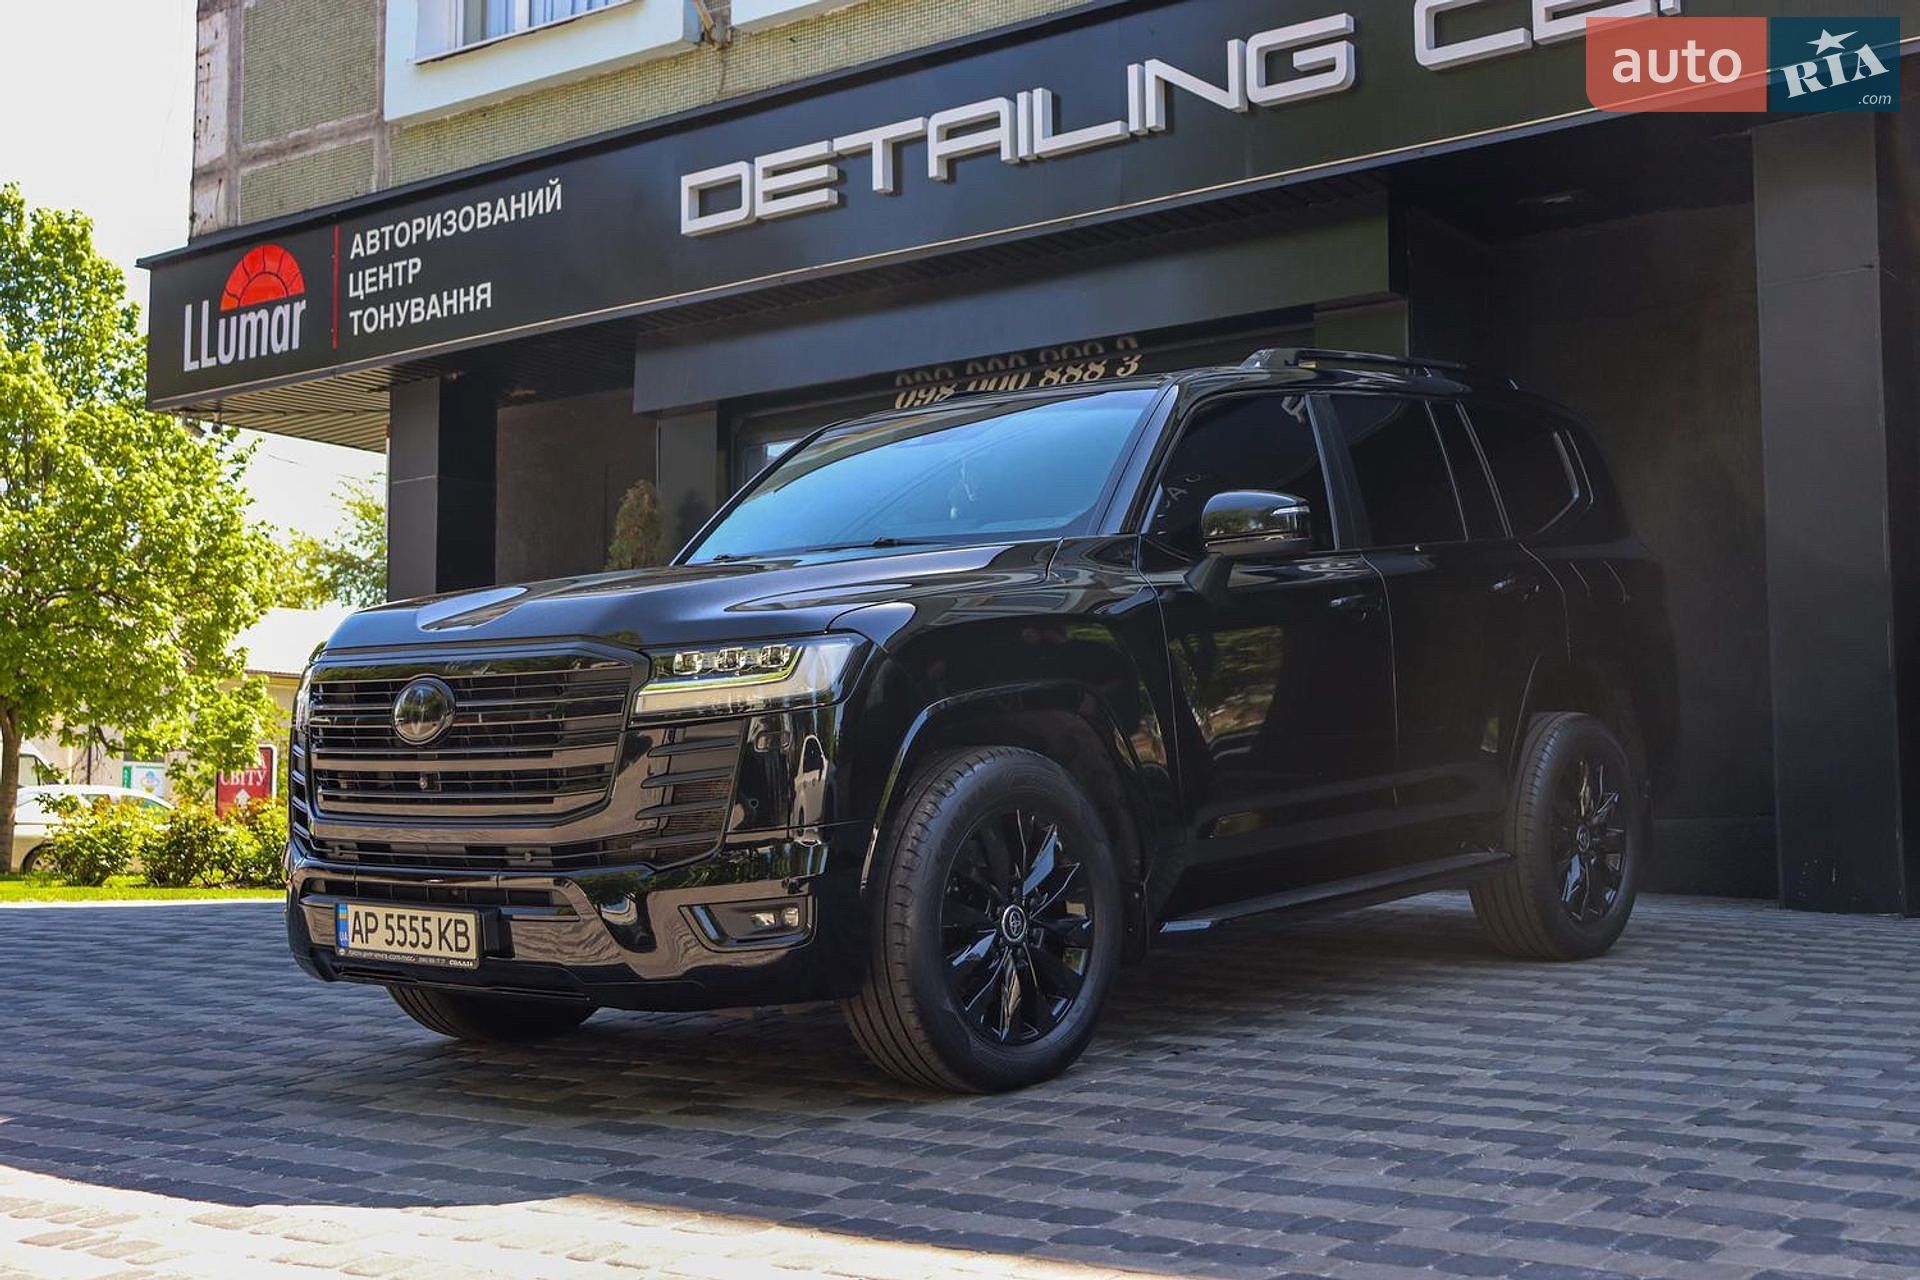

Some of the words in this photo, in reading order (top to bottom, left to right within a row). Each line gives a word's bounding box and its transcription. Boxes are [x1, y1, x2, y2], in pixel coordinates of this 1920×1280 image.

[681, 12, 1356, 236] DETAILING
[1414, 0, 1682, 71] CE
[349, 178, 563, 259] АВТОРИЗОВАНИЙ
[348, 257, 422, 300] ЦЕНТР
[349, 281, 492, 336] ТОНУВАННЯ
[183, 298, 306, 372] LLumar
[352, 911, 378, 944] AP
[384, 912, 433, 950] 5555
[438, 917, 470, 952] KB
